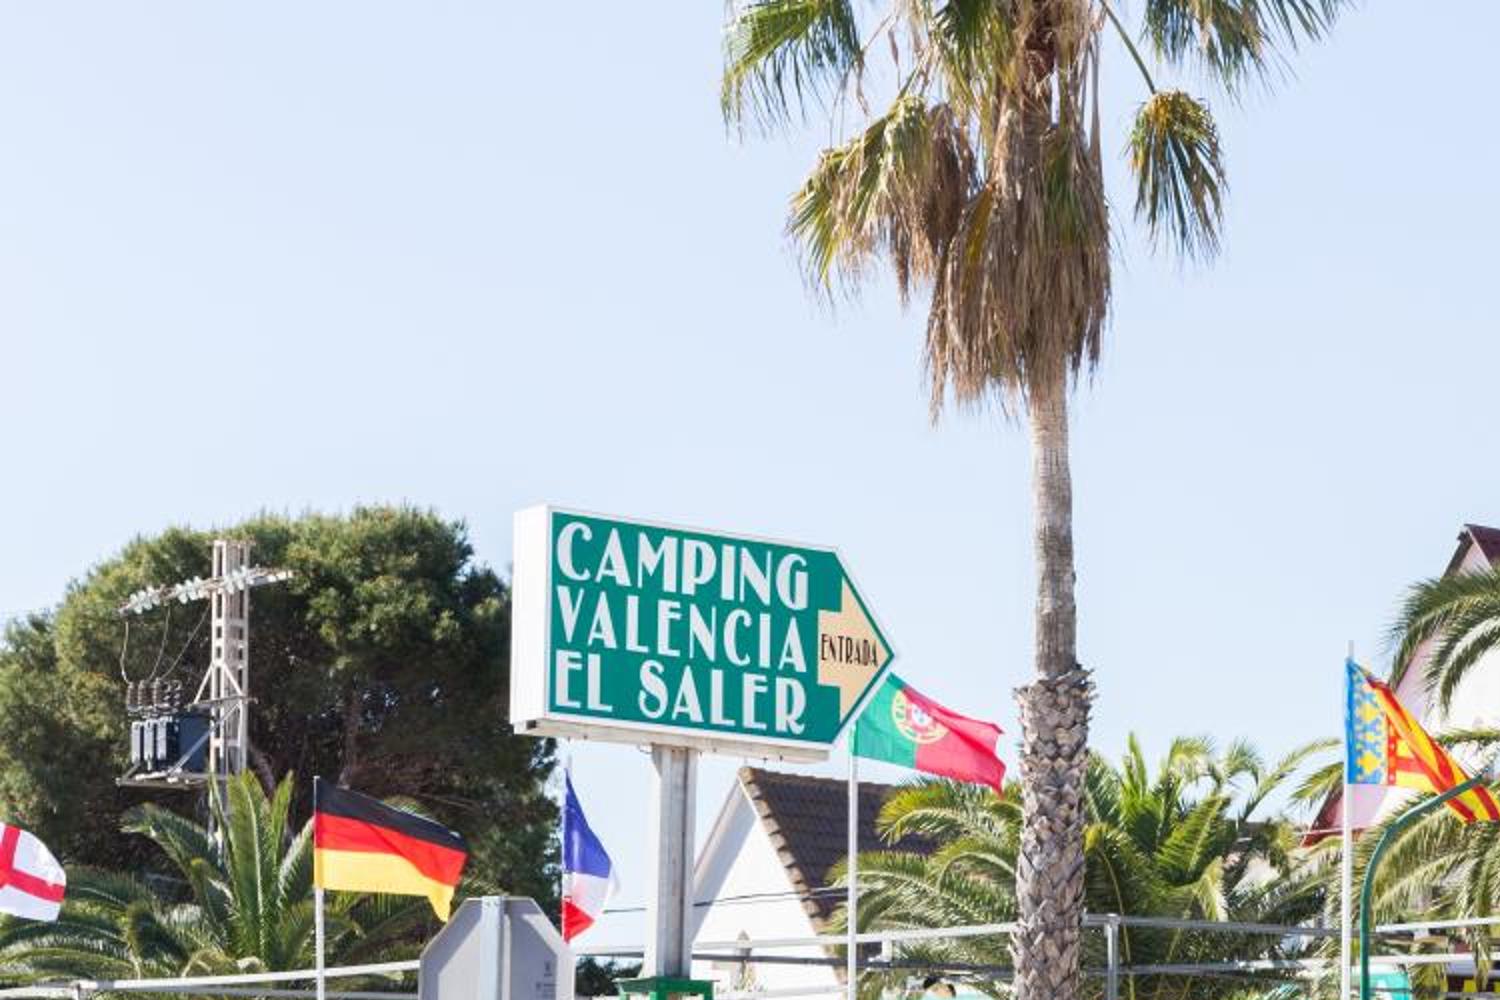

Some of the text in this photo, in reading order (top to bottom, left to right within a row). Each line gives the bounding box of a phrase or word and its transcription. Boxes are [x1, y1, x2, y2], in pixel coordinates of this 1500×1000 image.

[557, 522, 809, 611] CAMPING
[556, 585, 808, 674] VALENCIA
[821, 633, 879, 668] ENTRADA
[554, 649, 807, 735] EL SALER
